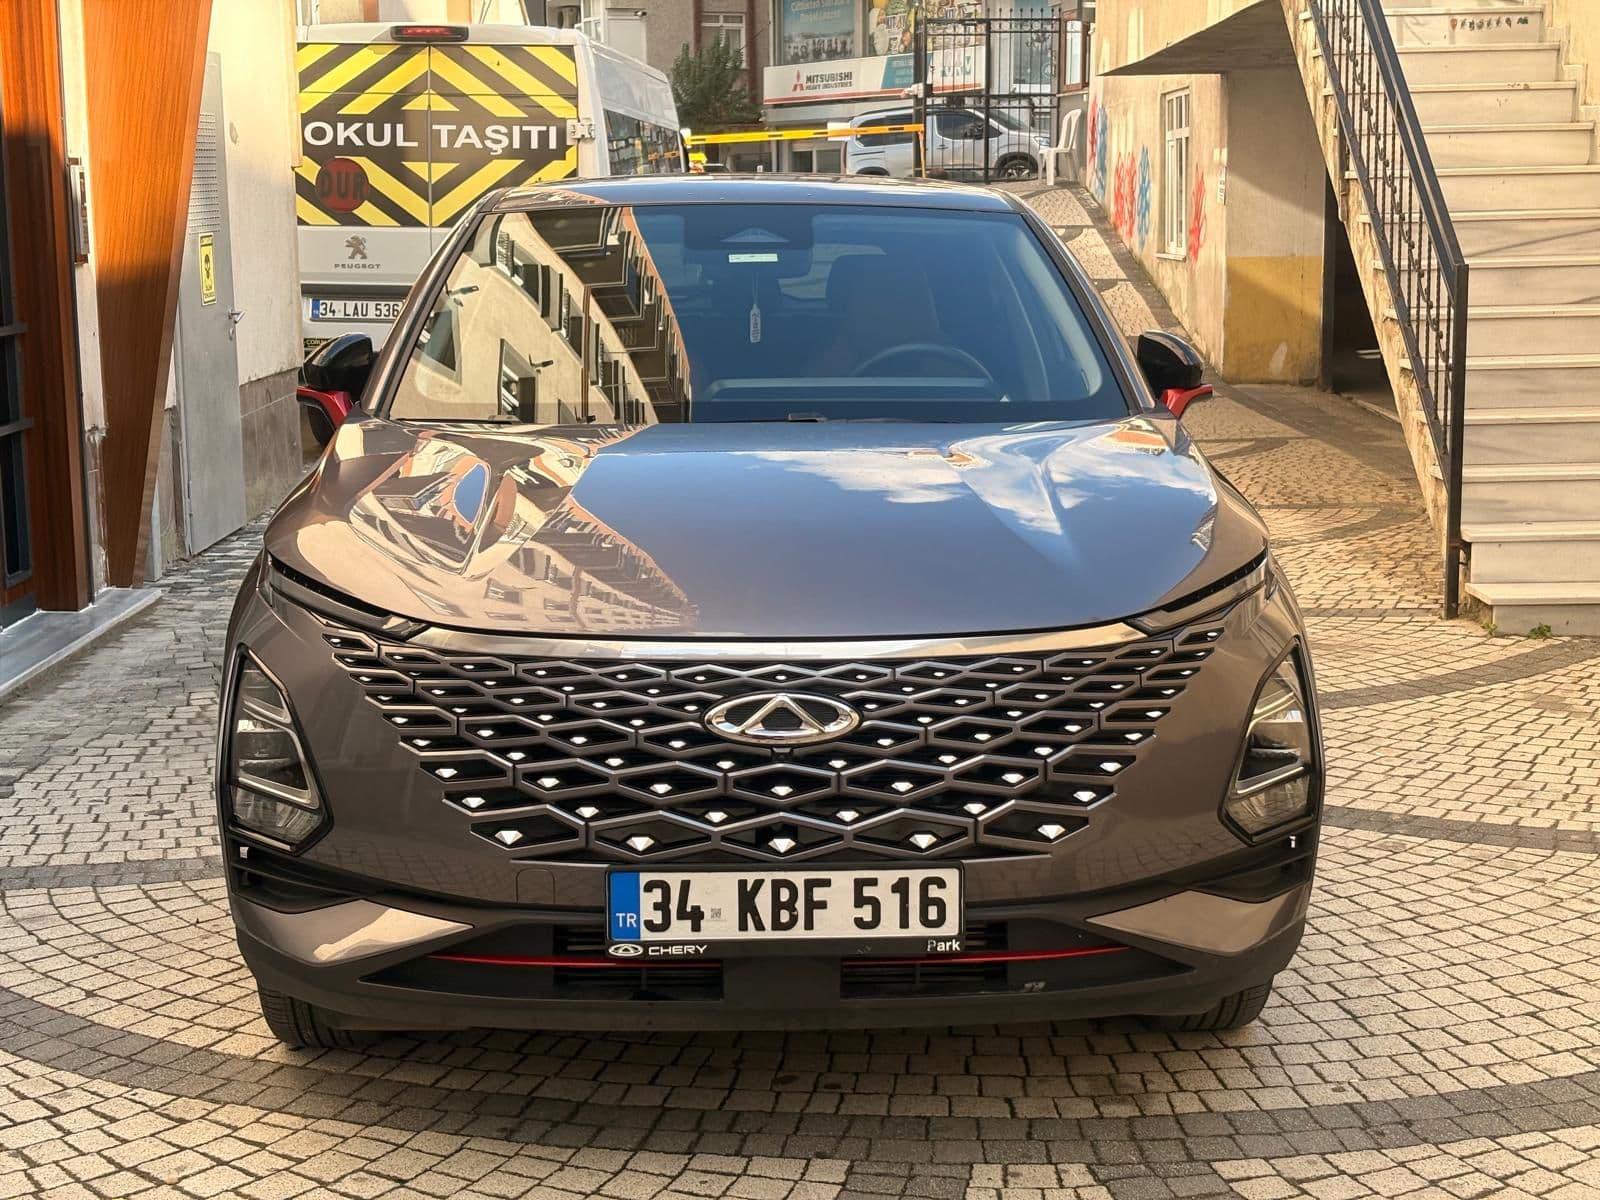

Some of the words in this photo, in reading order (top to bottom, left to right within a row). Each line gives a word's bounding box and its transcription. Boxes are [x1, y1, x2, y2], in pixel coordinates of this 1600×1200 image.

[806, 71, 853, 84] MITSUBISHI
[303, 121, 418, 147] OKUL
[431, 124, 557, 155] TAŞITI
[319, 171, 367, 201] DUR
[320, 302, 336, 317] 34
[343, 302, 369, 318] LAU
[374, 303, 400, 318] 536
[616, 912, 638, 928] TR
[643, 878, 705, 933] 34
[737, 877, 832, 932] KBF
[853, 876, 947, 930] 516
[648, 944, 708, 956] CHERY
[927, 938, 961, 952] Park
